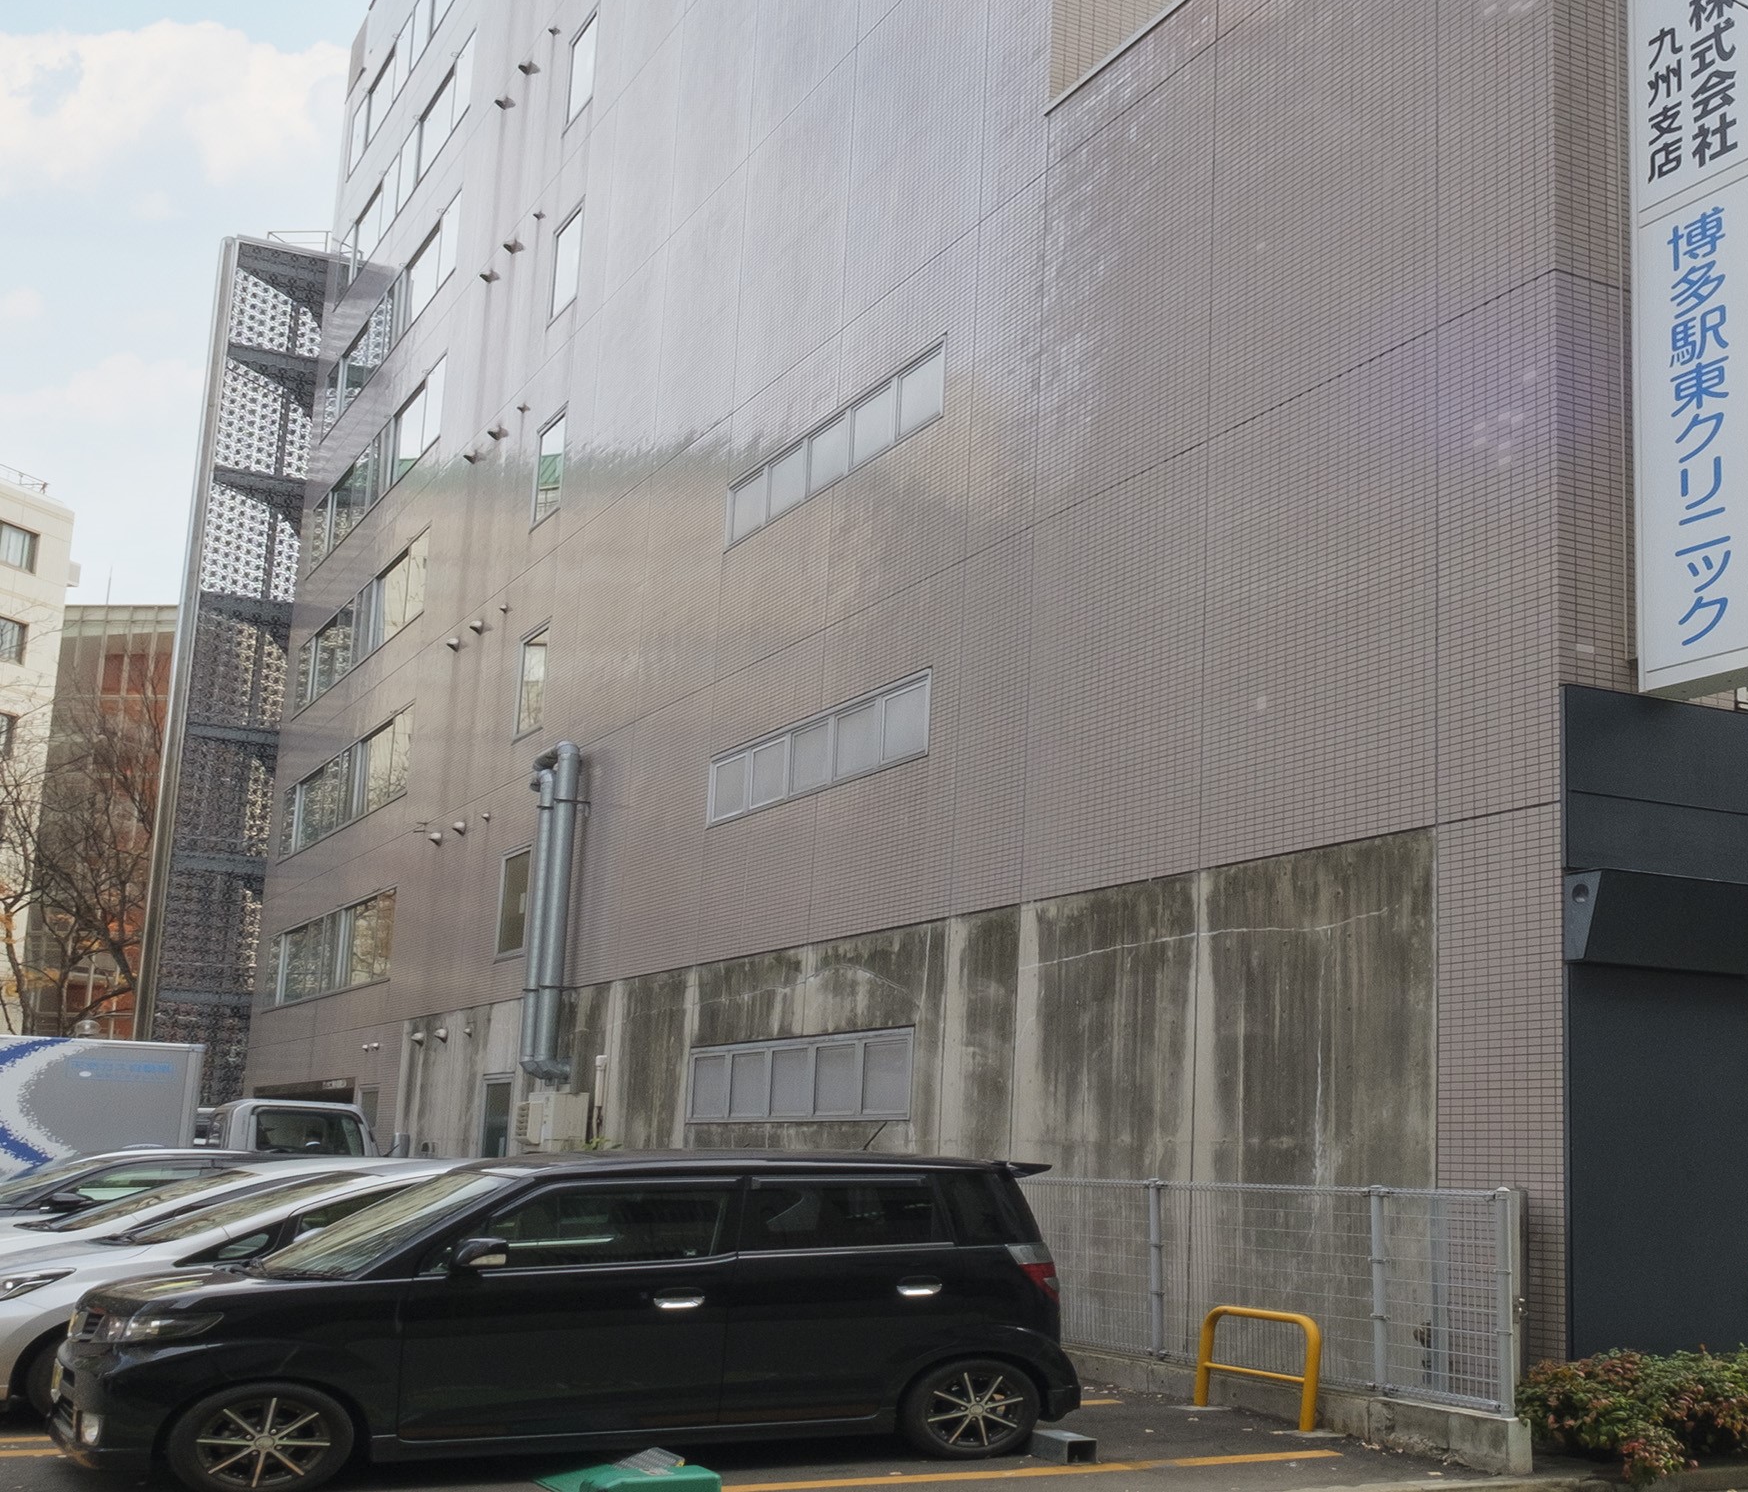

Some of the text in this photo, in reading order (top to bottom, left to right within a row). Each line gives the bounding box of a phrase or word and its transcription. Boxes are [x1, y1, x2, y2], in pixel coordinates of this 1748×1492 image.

[1647, 26, 1684, 183] 九州支店
[1666, 205, 1732, 647] 博多駅東クリニック
